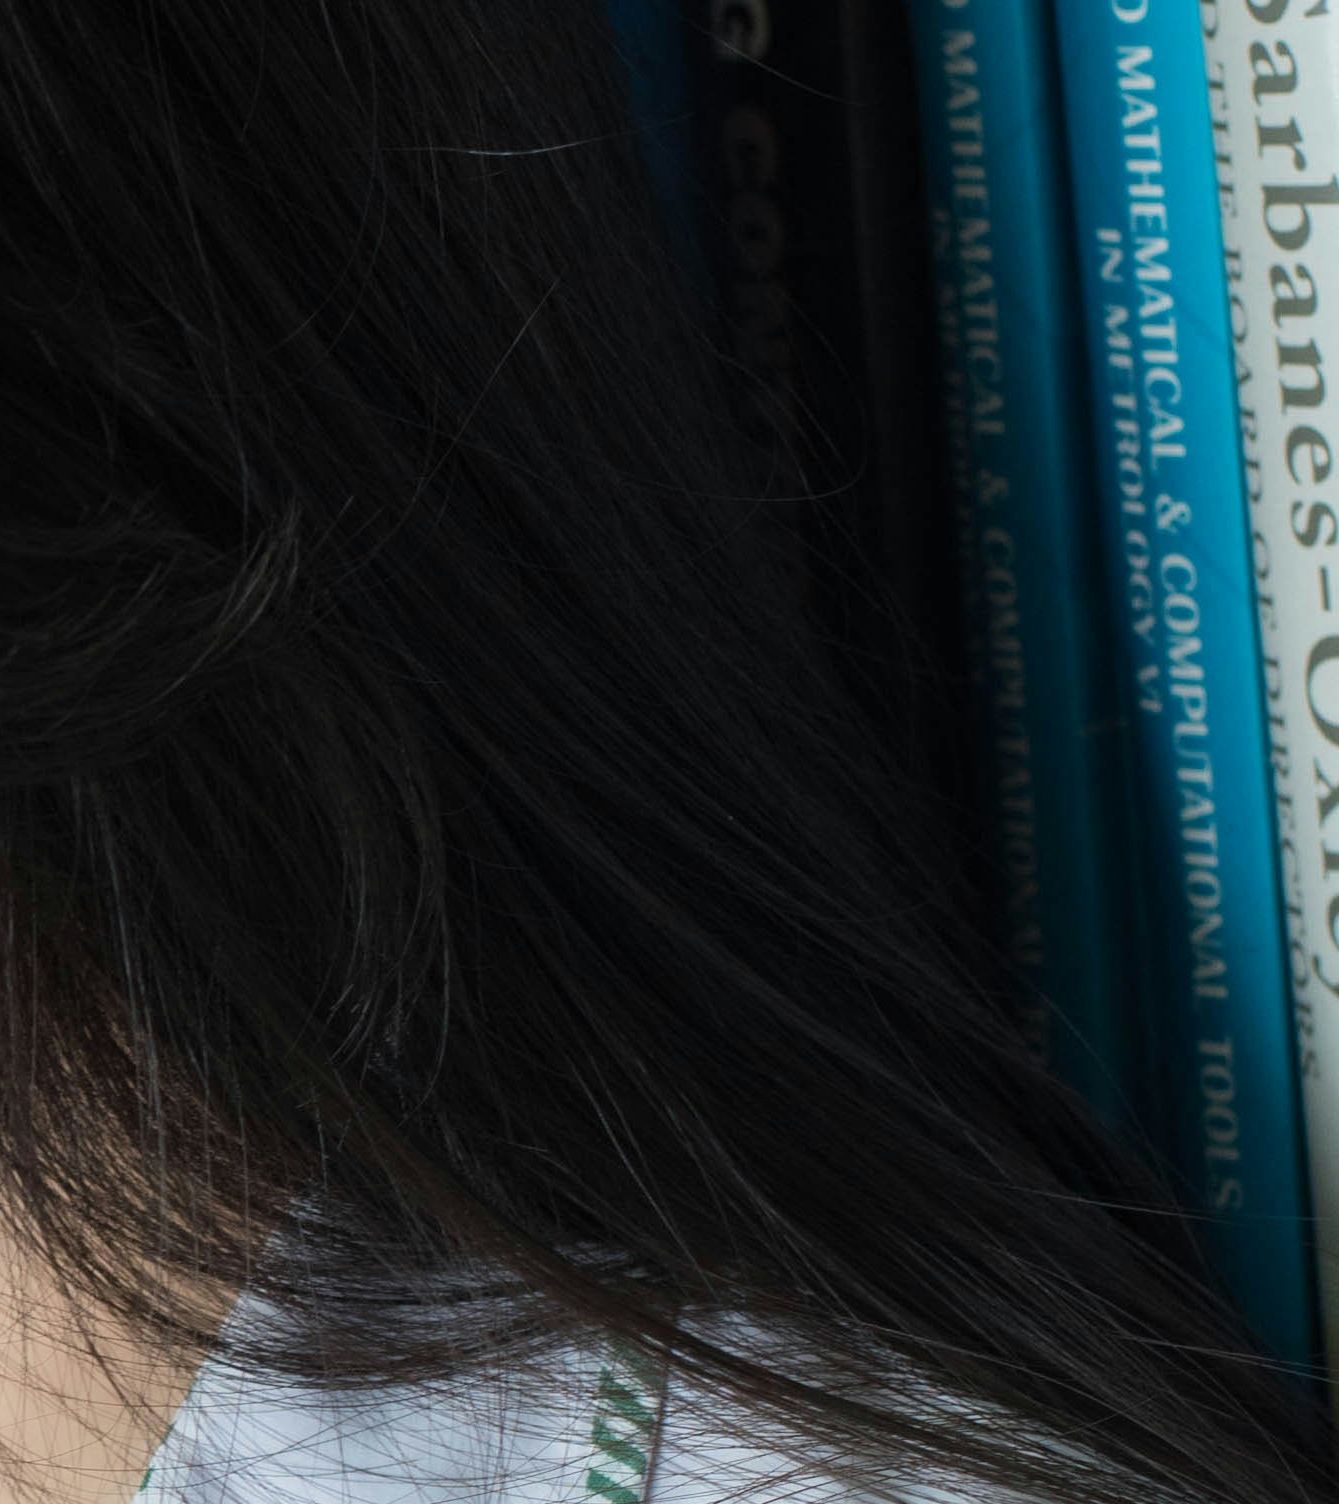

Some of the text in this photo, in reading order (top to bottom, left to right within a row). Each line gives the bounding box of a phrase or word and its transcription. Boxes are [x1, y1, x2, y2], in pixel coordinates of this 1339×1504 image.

[941, 28, 1006, 442] MATHEMATICAL
[1095, 225, 1125, 284] IN
[1116, 44, 1187, 471] MATHEMATICAL
[1211, 63, 1238, 217] THE
[1103, 302, 1157, 647] METROLOGY
[1154, 492, 1193, 534] &
[1159, 552, 1230, 1002] COMPUTATIONAL
[1196, 1034, 1244, 1210] TOOLS
